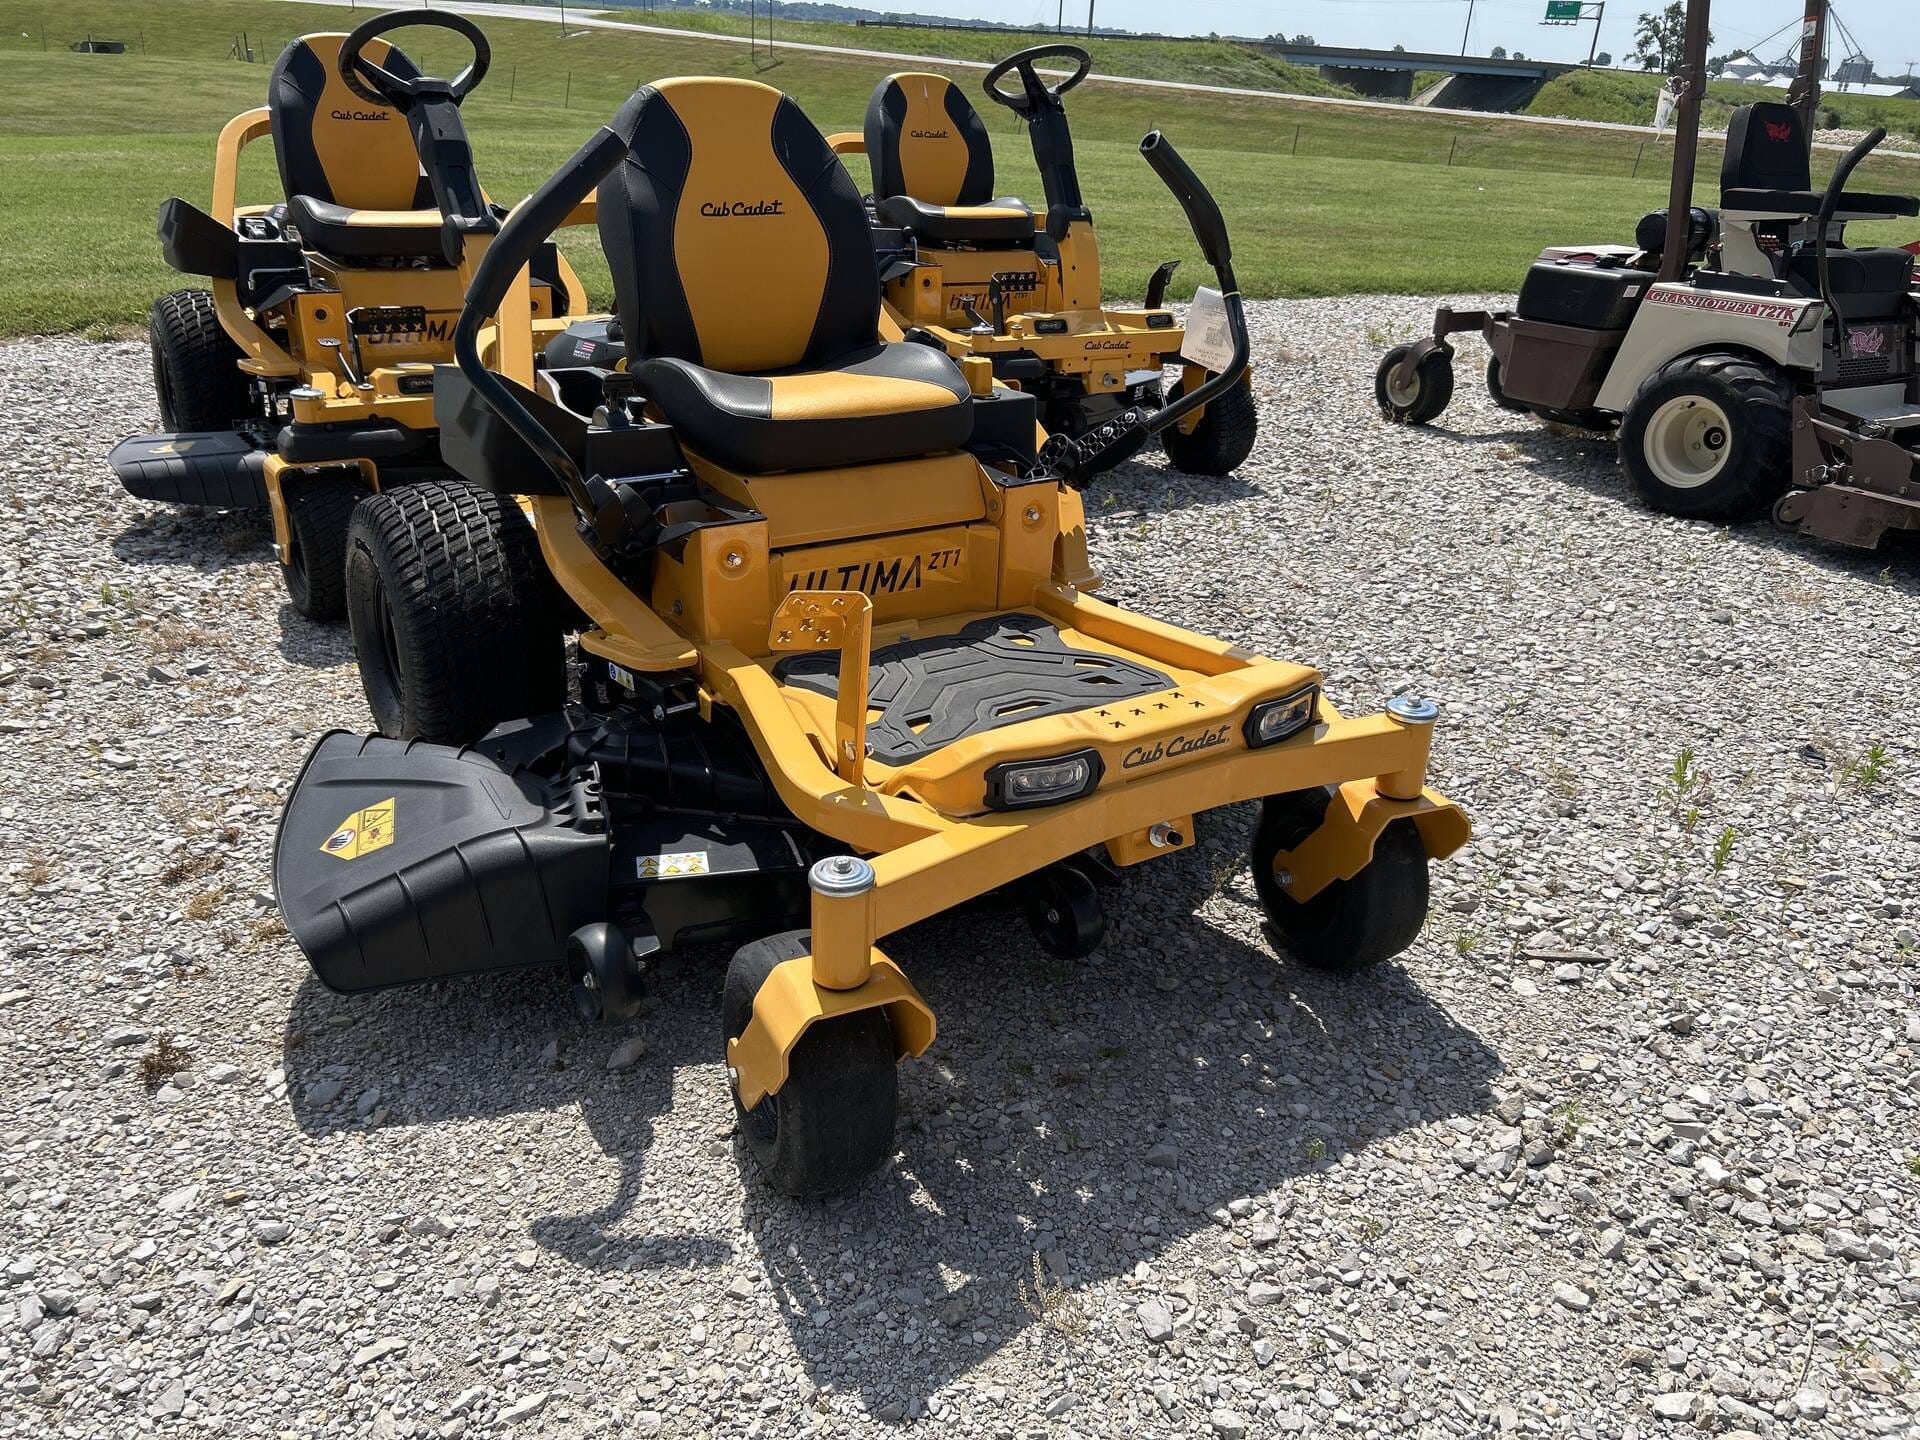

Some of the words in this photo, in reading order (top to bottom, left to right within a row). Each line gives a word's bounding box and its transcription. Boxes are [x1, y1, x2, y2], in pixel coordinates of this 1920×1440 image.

[331, 110, 352, 120] Cub
[353, 111, 390, 121] Cadet
[911, 130, 923, 138] Cub
[700, 202, 730, 217] Cub
[732, 200, 783, 216] Cadet
[1650, 291, 1753, 315] GRASSHOPPER
[1755, 303, 1798, 321] 727K
[1084, 341, 1101, 350] Cub
[1103, 341, 1131, 350] Cadet
[927, 549, 962, 571] ZT1
[1122, 742, 1164, 769] Cub
[1166, 724, 1232, 757] Cadet
